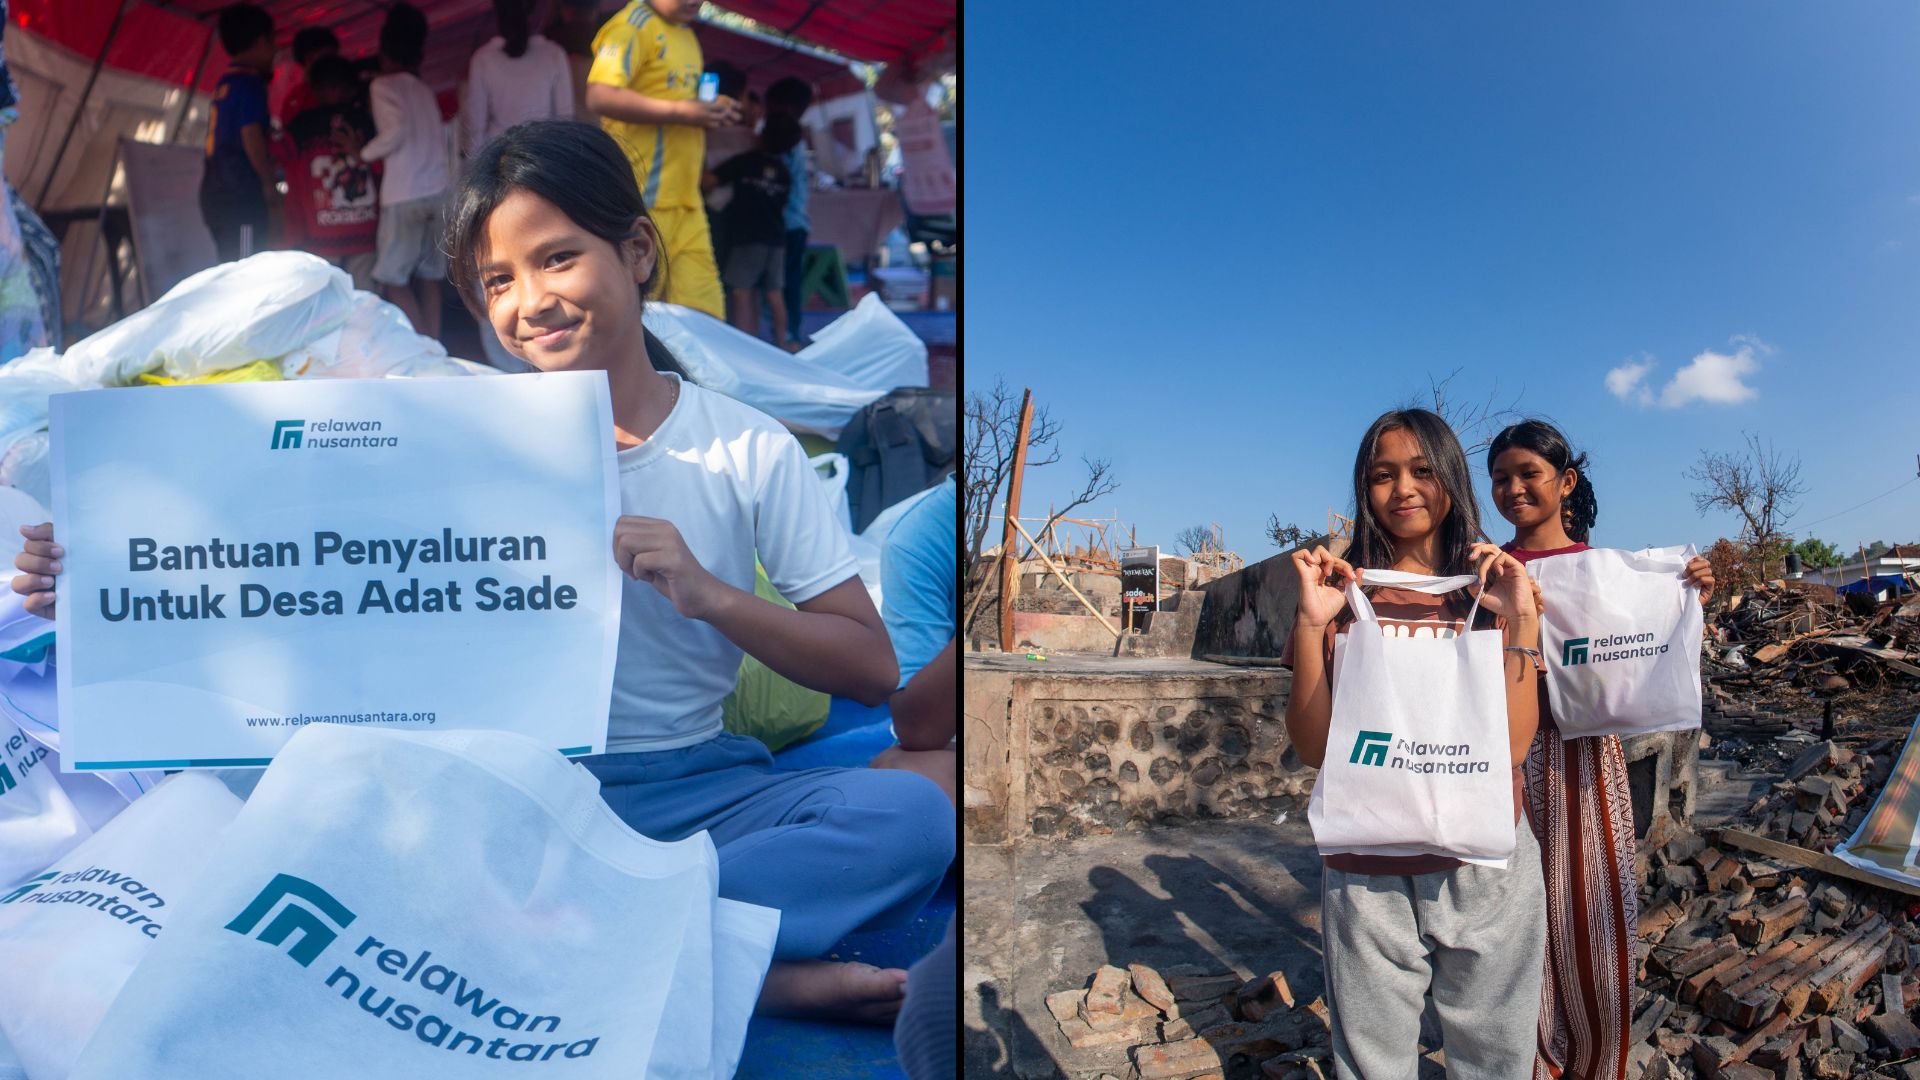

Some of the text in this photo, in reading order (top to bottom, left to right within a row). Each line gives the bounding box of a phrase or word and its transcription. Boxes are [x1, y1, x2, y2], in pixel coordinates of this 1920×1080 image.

[310, 418, 382, 433] relawan
[307, 435, 398, 449] nusantara
[128, 528, 547, 573] Bantuan Penyaluran
[99, 575, 578, 622] Untuk Desa Adat Sade
[1125, 587, 1144, 597] sade
[1594, 632, 1655, 648] relawan
[1592, 643, 1669, 663] nusantara
[246, 711, 436, 726] www.relawannusantara.org
[1391, 756, 1490, 774] nusantara
[50, 865, 165, 909] relawan
[354, 935, 562, 1033] relawan
[324, 965, 600, 1061] nusantara
